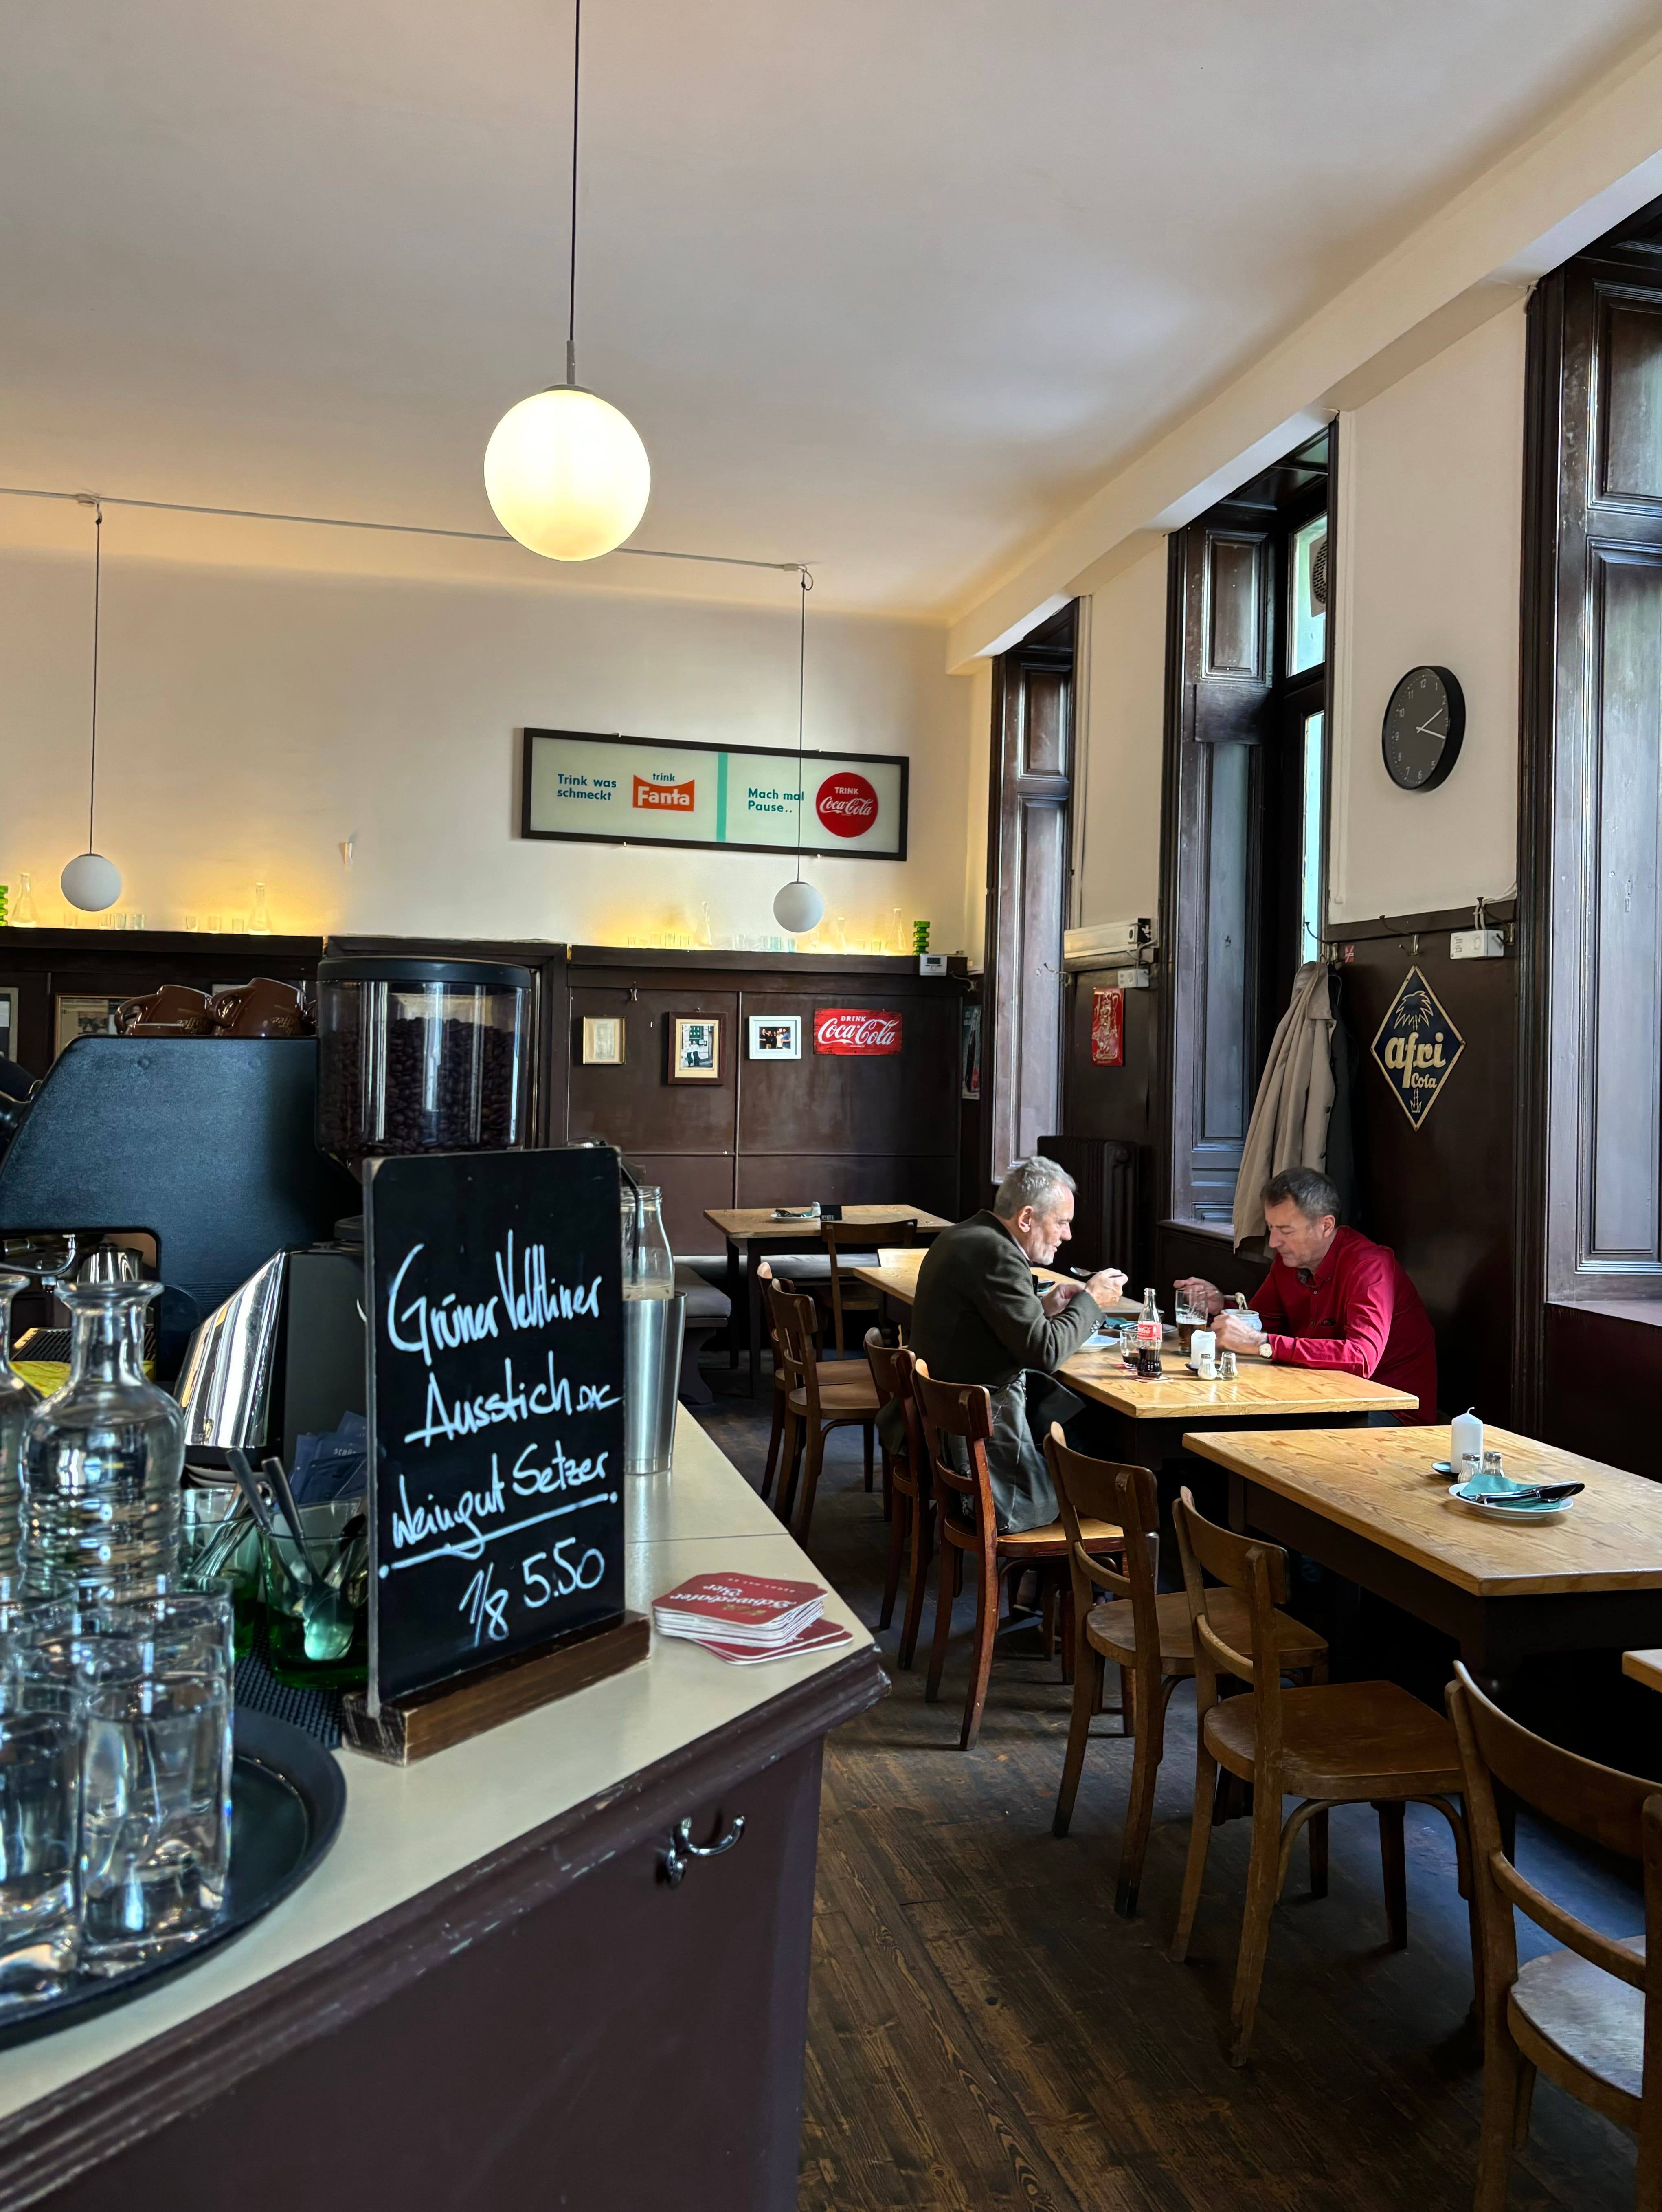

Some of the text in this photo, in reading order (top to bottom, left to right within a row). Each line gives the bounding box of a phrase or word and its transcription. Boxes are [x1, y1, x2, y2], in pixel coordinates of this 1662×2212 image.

[1408, 690, 1414, 699] 11
[558, 773, 617, 788] Trink was
[652, 772, 675, 781] trink
[557, 787, 612, 800] schmeckt
[638, 786, 690, 806] Fanta
[748, 787, 804, 801] Mach mal
[819, 796, 874, 816] Coca-Cola
[817, 1018, 899, 1045] Coca-Cola
[1385, 1031, 1446, 1088] afri
[1411, 1072, 1437, 1088] Cola
[387, 1229, 602, 1367] Grüner Veltliner
[404, 1350, 573, 1447] Ausstich
[392, 1440, 609, 1560] Weingut Setzer
[459, 1536, 605, 1648] 1/8 5.50
